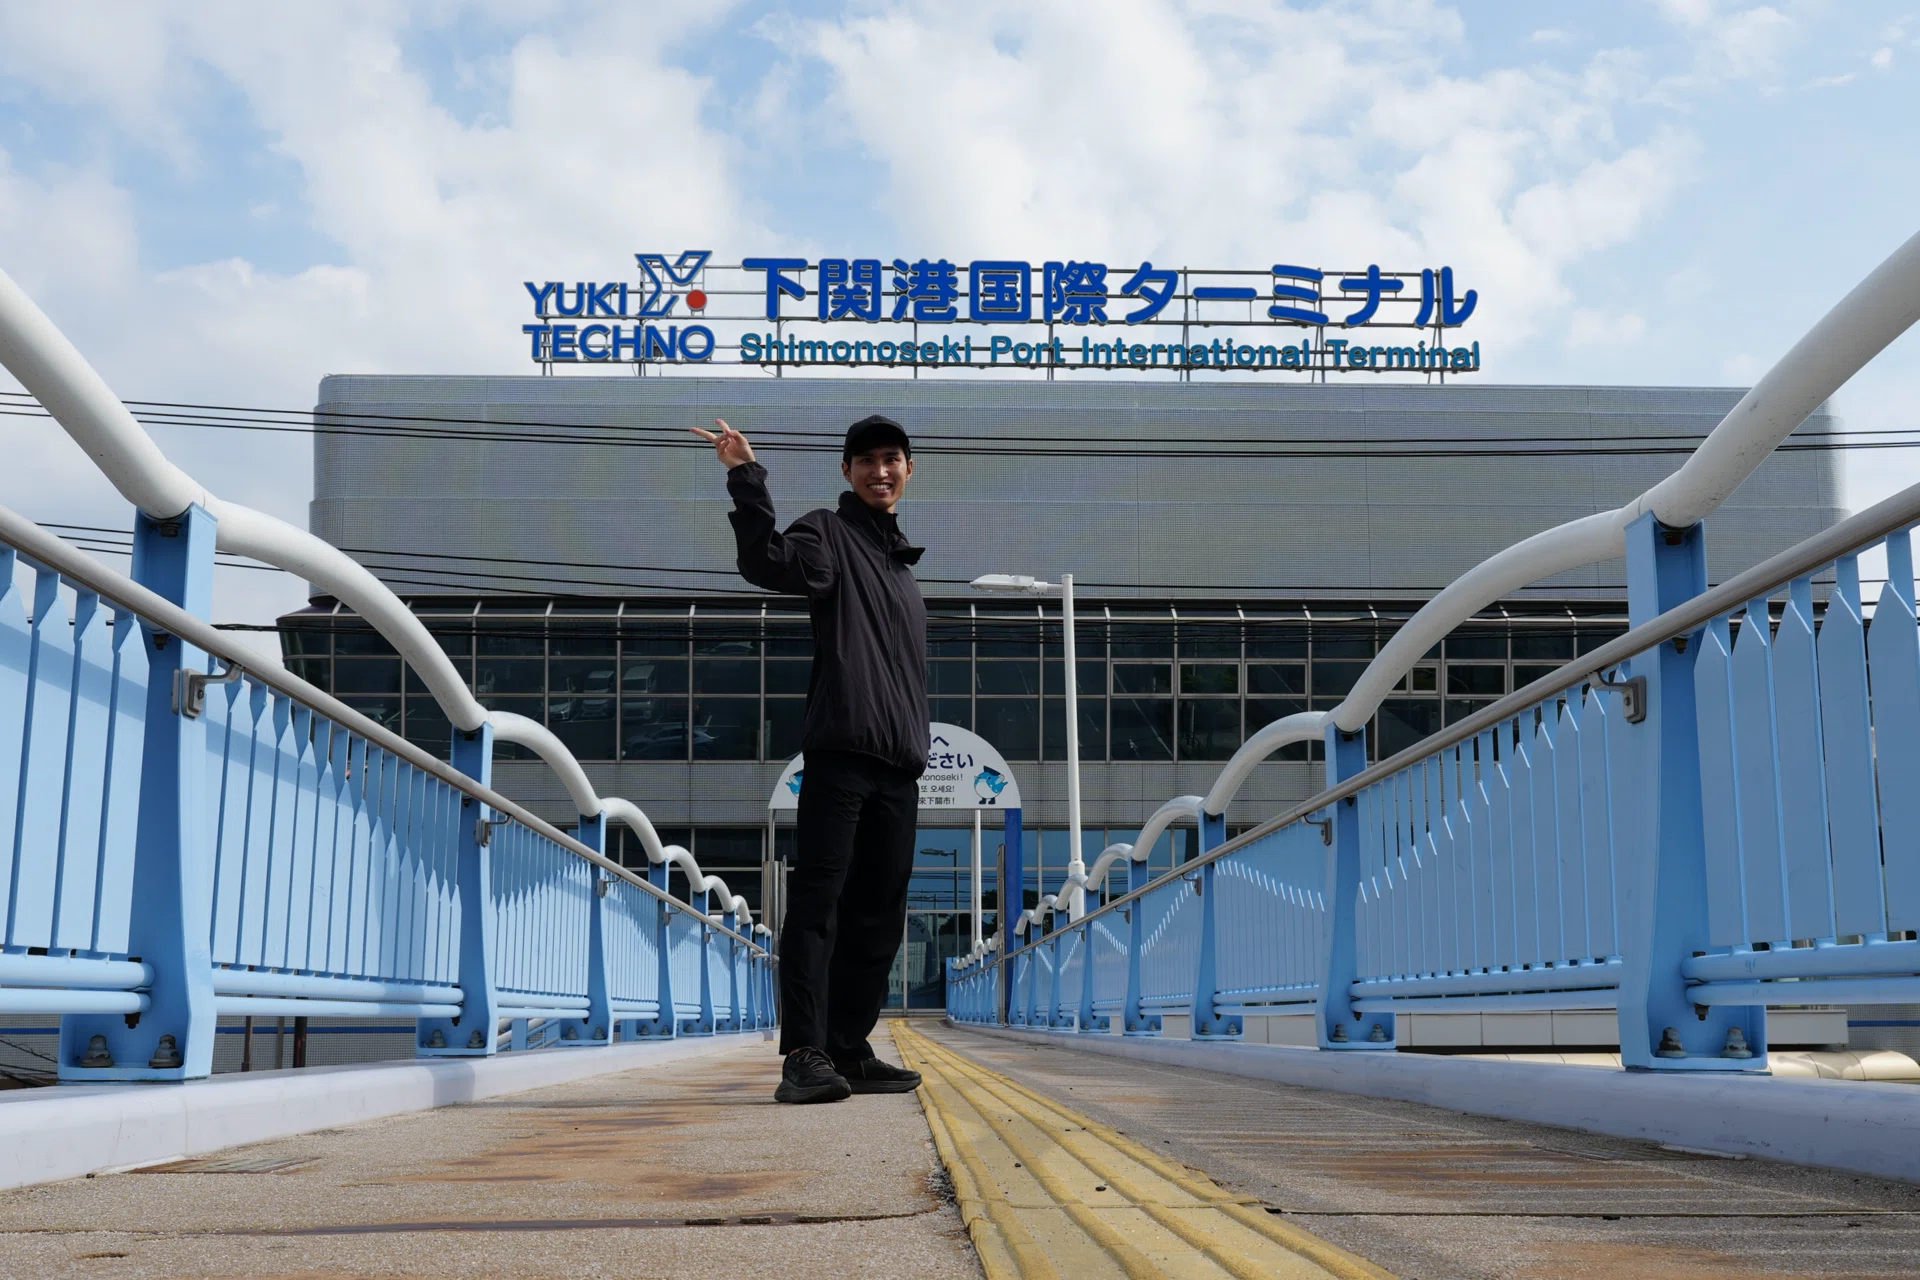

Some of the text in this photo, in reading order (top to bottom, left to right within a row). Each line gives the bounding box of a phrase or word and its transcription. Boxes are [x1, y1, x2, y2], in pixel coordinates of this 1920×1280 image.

[524, 282, 628, 317] YUKI
[741, 257, 1479, 327] 下関港国際ターミナル
[522, 324, 716, 361] TECHNO
[740, 333, 1480, 369] Shimonoseki Port International Terminal
[930, 784, 955, 793] 오세요!
